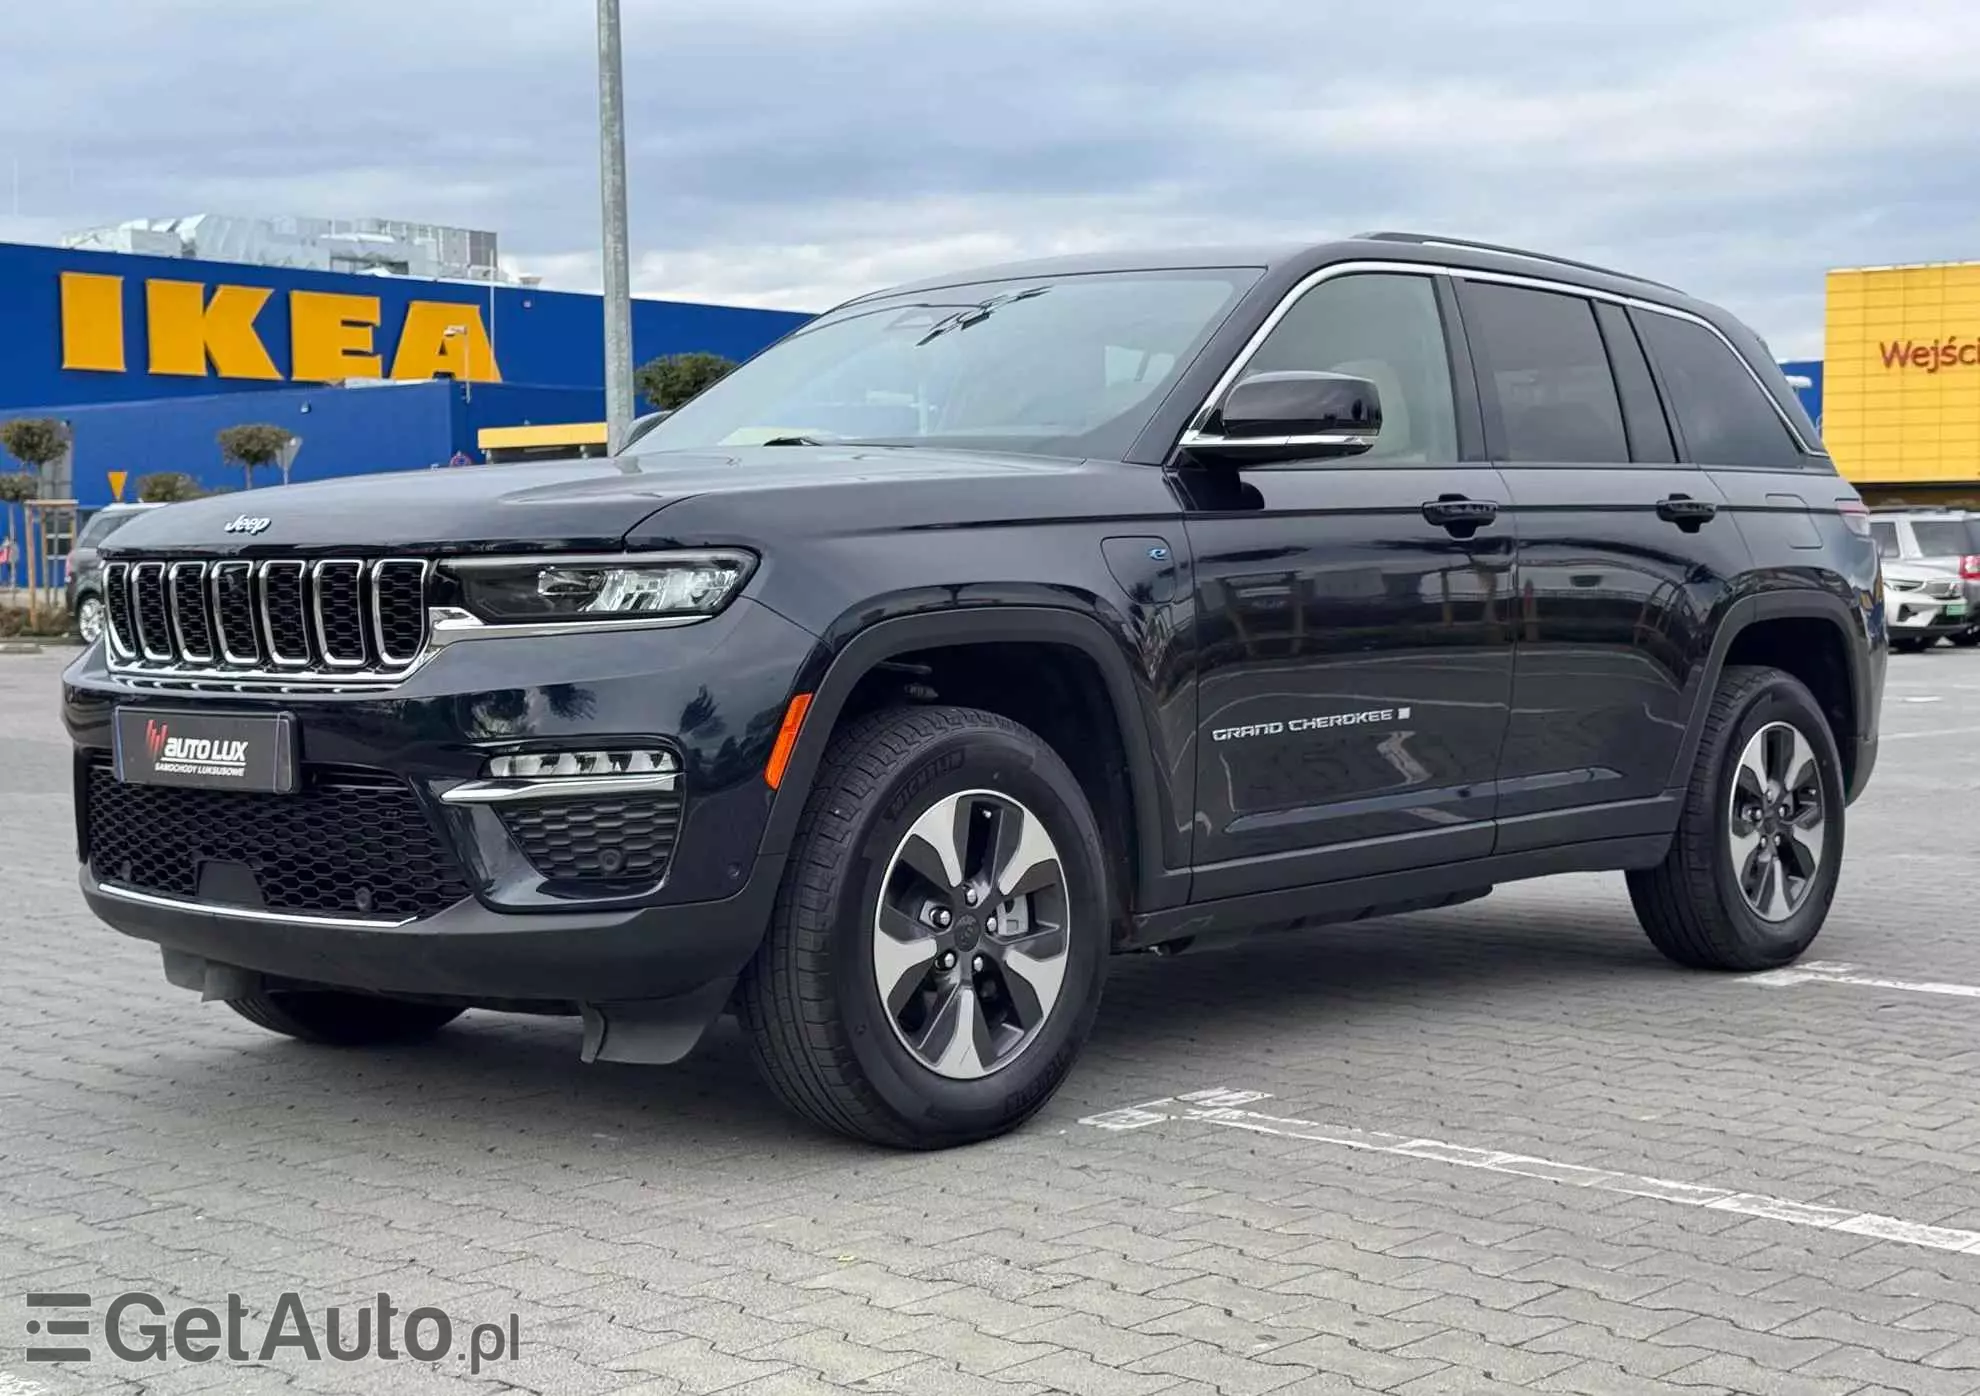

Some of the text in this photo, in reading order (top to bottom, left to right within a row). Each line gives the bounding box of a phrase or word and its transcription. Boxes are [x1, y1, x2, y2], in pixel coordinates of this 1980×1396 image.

[60, 272, 502, 382] IKEA
[224, 514, 272, 536] Jeep
[1212, 708, 1394, 741] GRAND CHEROKEE
[211, 740, 249, 761] LUX
